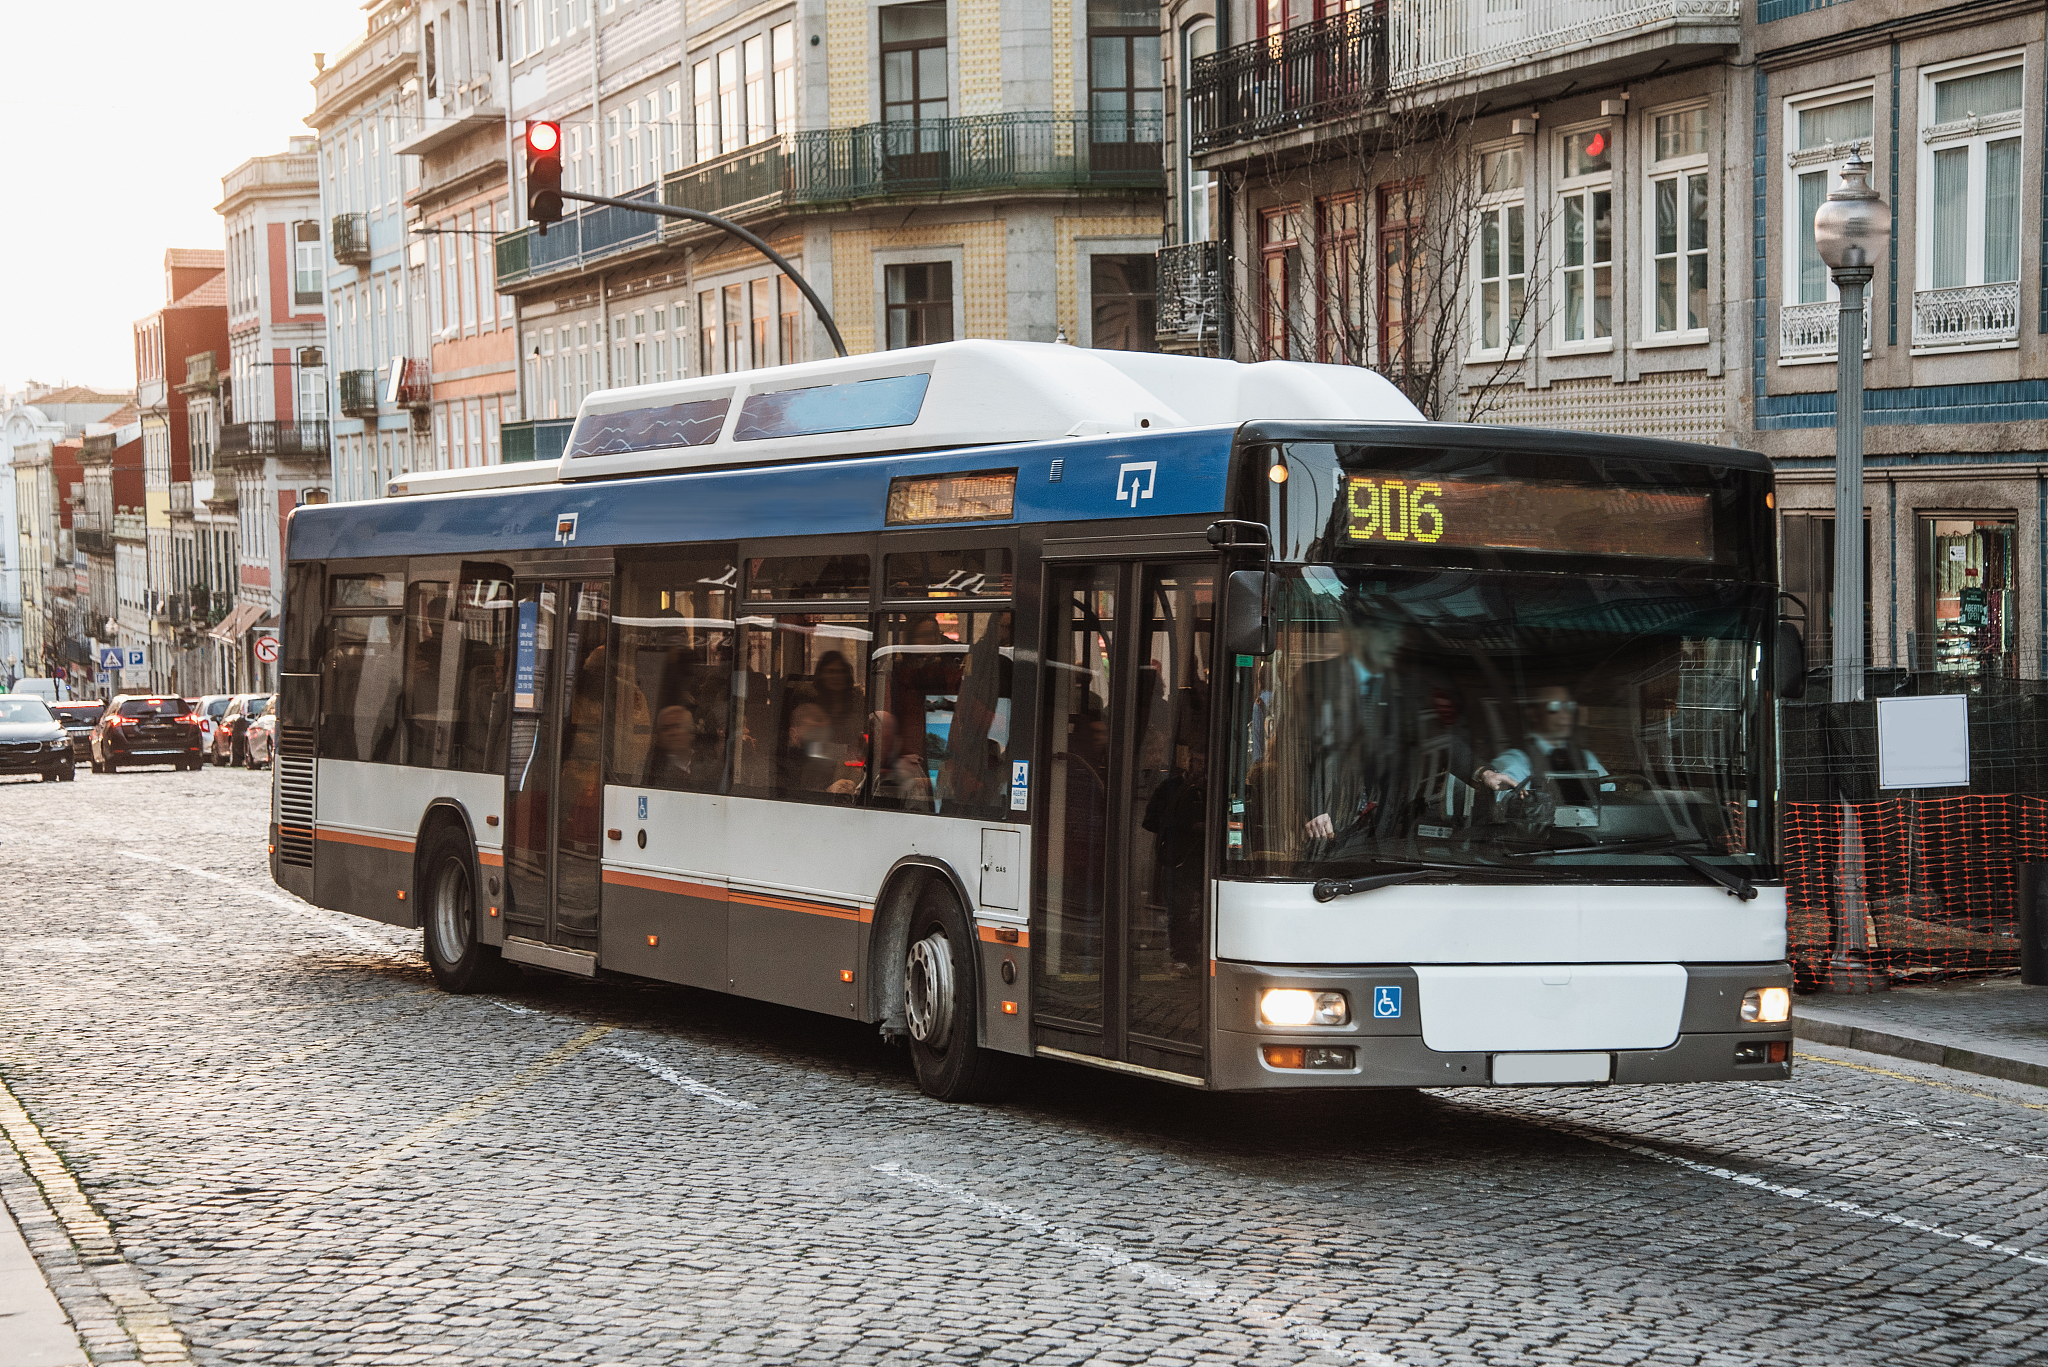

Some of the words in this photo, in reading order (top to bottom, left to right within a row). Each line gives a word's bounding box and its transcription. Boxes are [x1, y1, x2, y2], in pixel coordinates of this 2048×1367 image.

[1348, 478, 1443, 543] 906
[1964, 603, 1984, 613] ABERTO
[1967, 612, 1981, 622] OPEN
